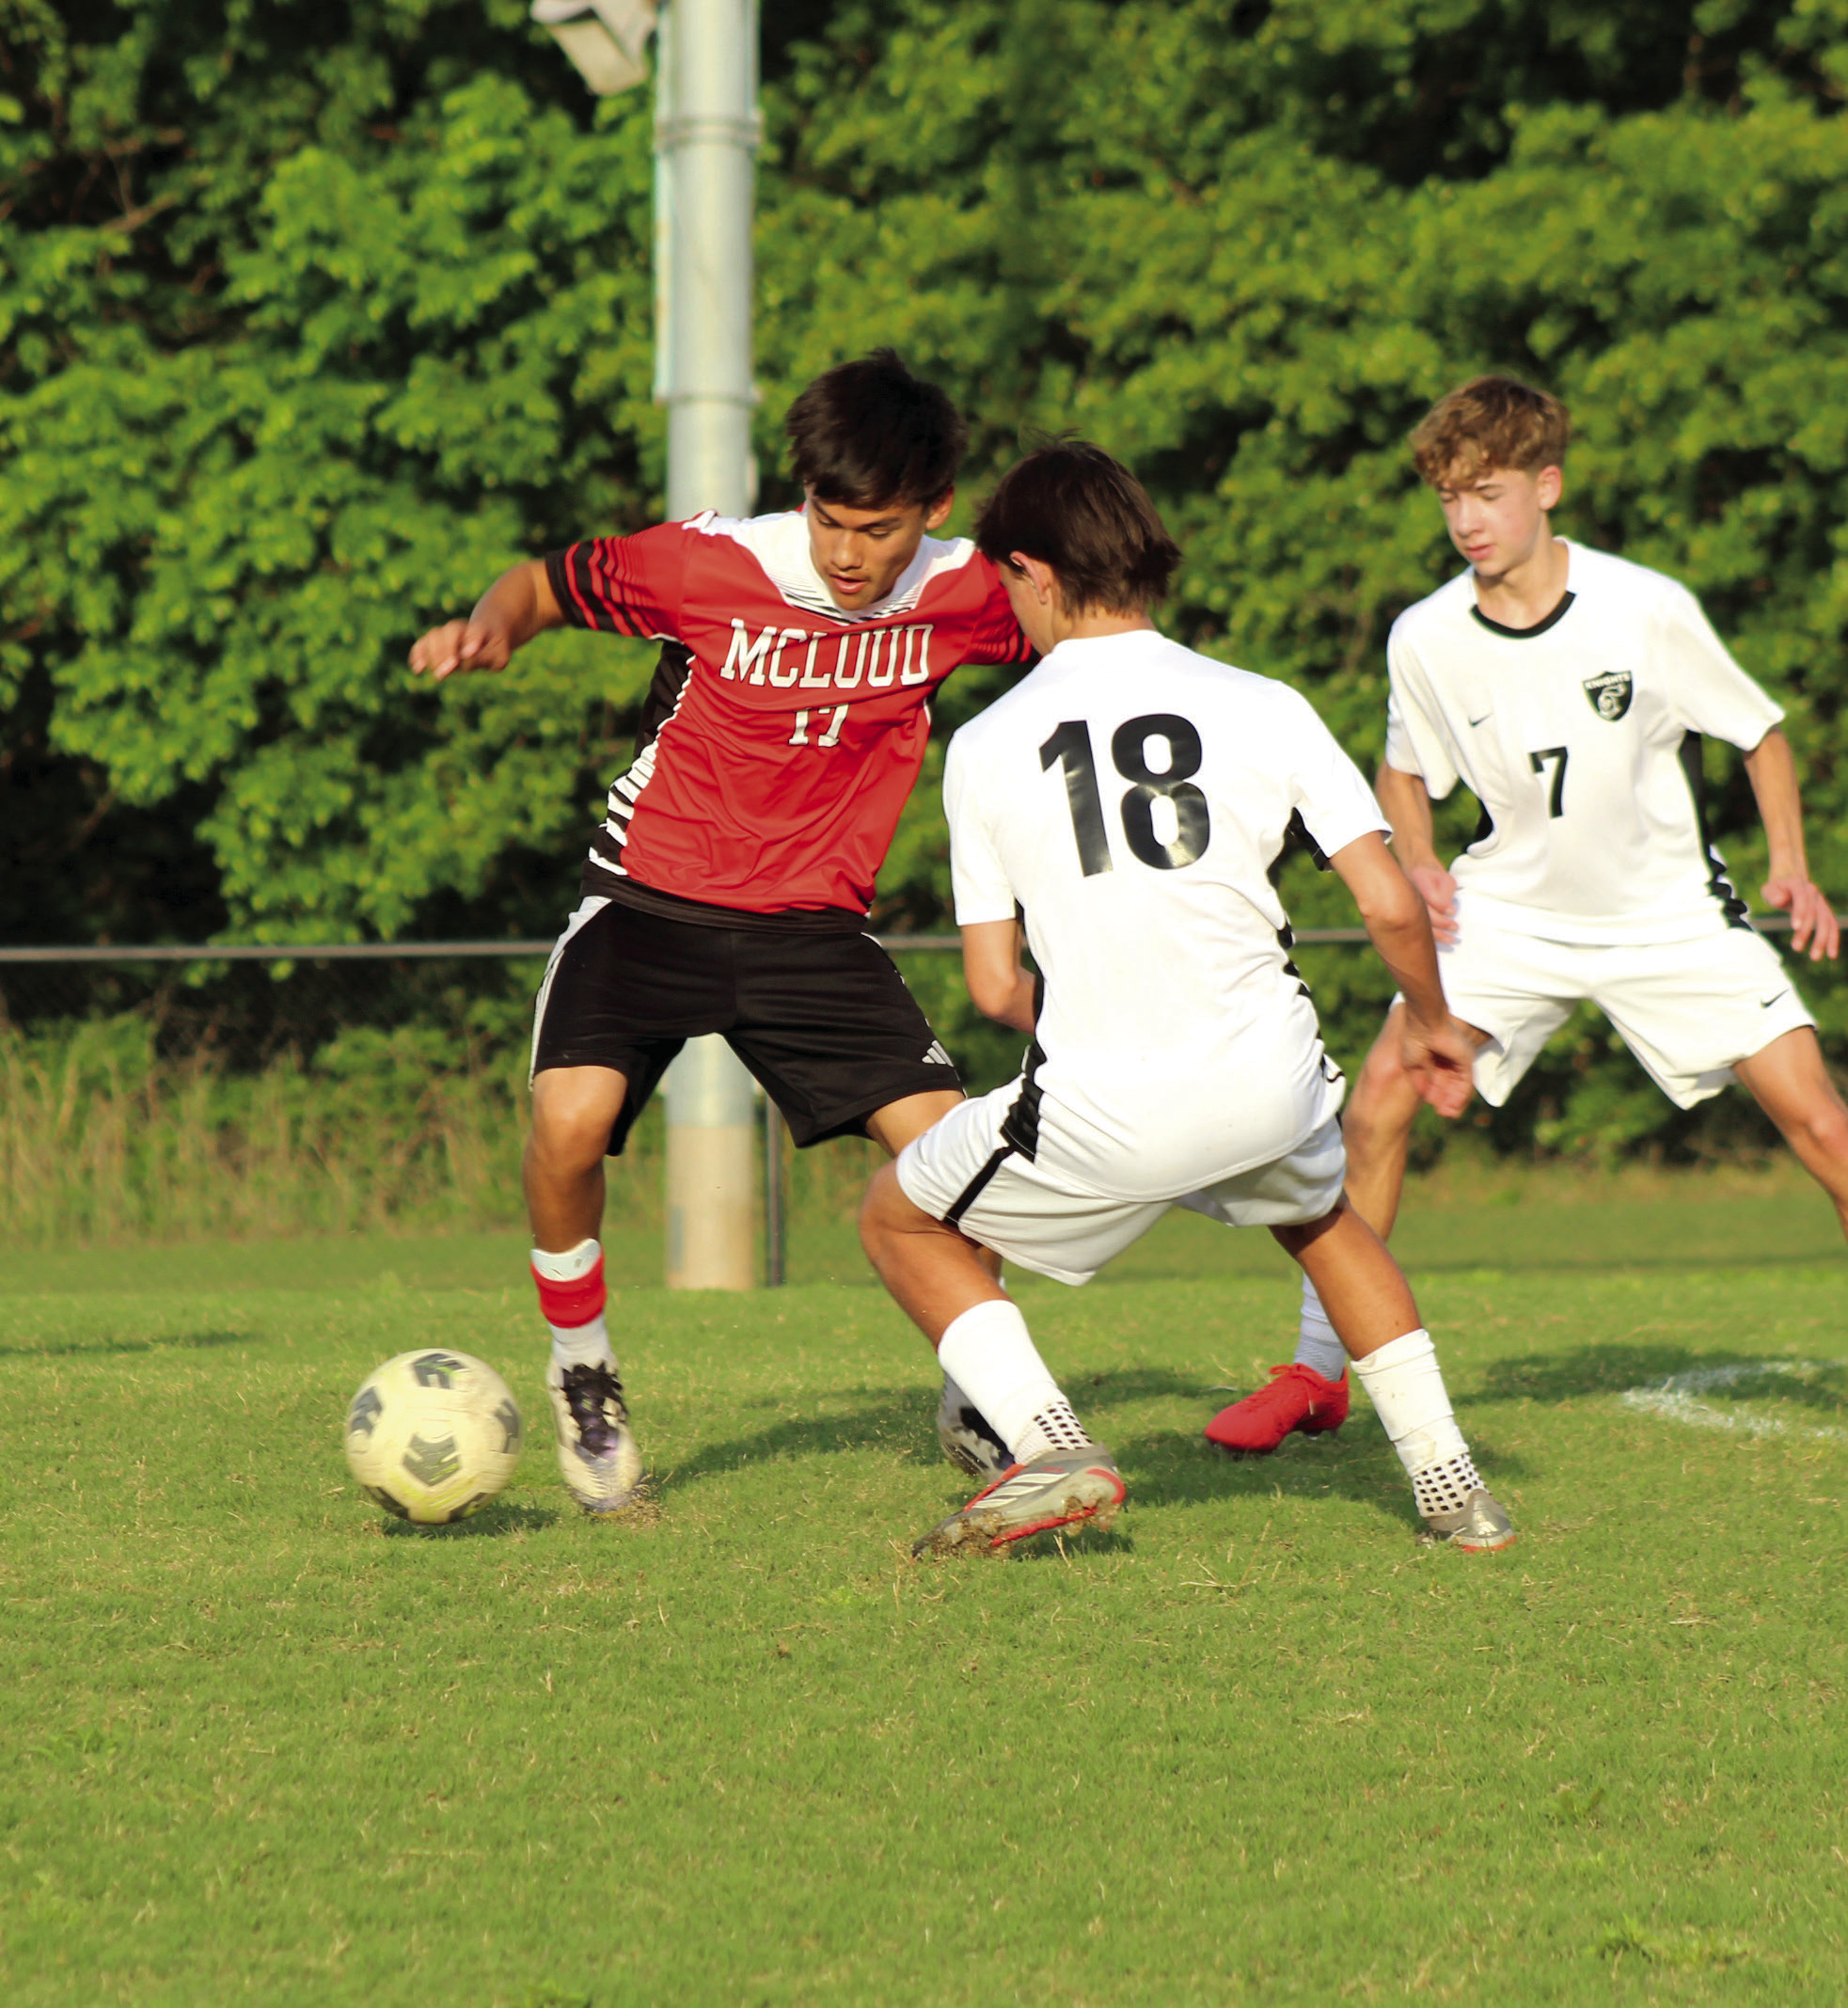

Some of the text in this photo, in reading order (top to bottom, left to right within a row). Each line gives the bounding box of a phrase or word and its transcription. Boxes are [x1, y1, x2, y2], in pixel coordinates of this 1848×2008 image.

[719, 618, 934, 688] MCLOUD
[788, 704, 849, 747] 17
[1038, 713, 1210, 878] 18
[1529, 746, 1569, 819] 7
